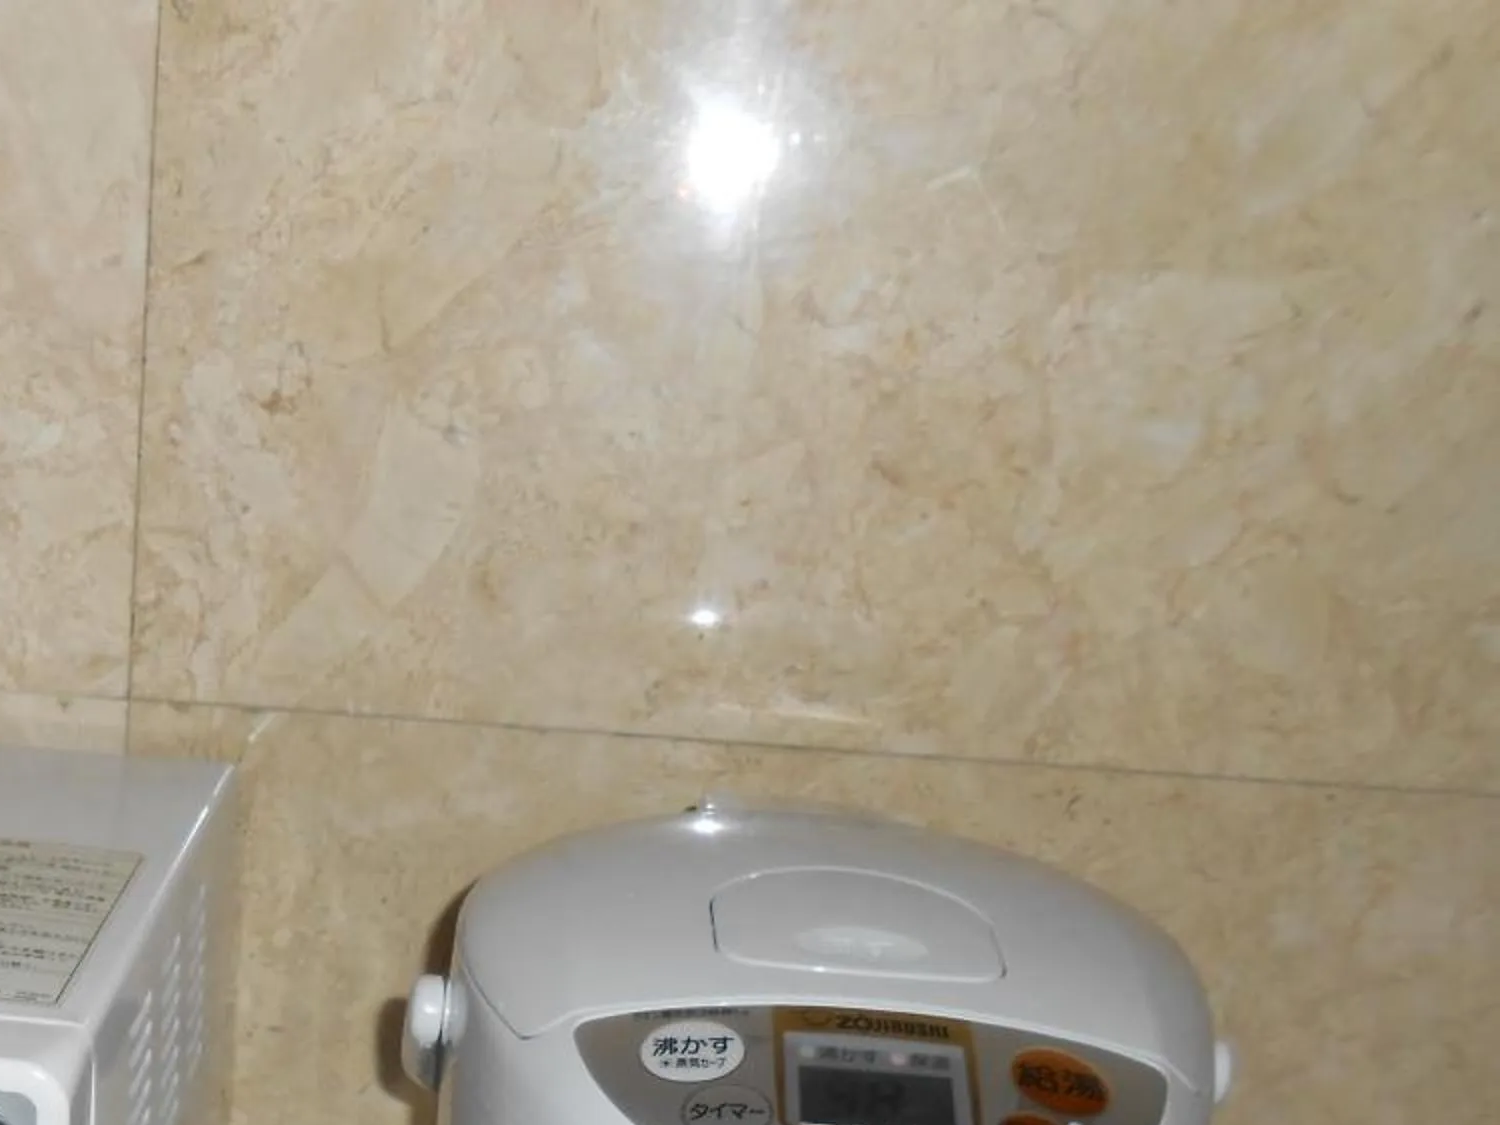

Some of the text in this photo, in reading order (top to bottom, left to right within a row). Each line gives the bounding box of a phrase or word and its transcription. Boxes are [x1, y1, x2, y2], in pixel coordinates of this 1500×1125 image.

[836, 1014, 950, 1038] ZOJIRUSHI
[652, 1035, 735, 1056] 沸かす
[690, 1103, 766, 1121] タイマー
